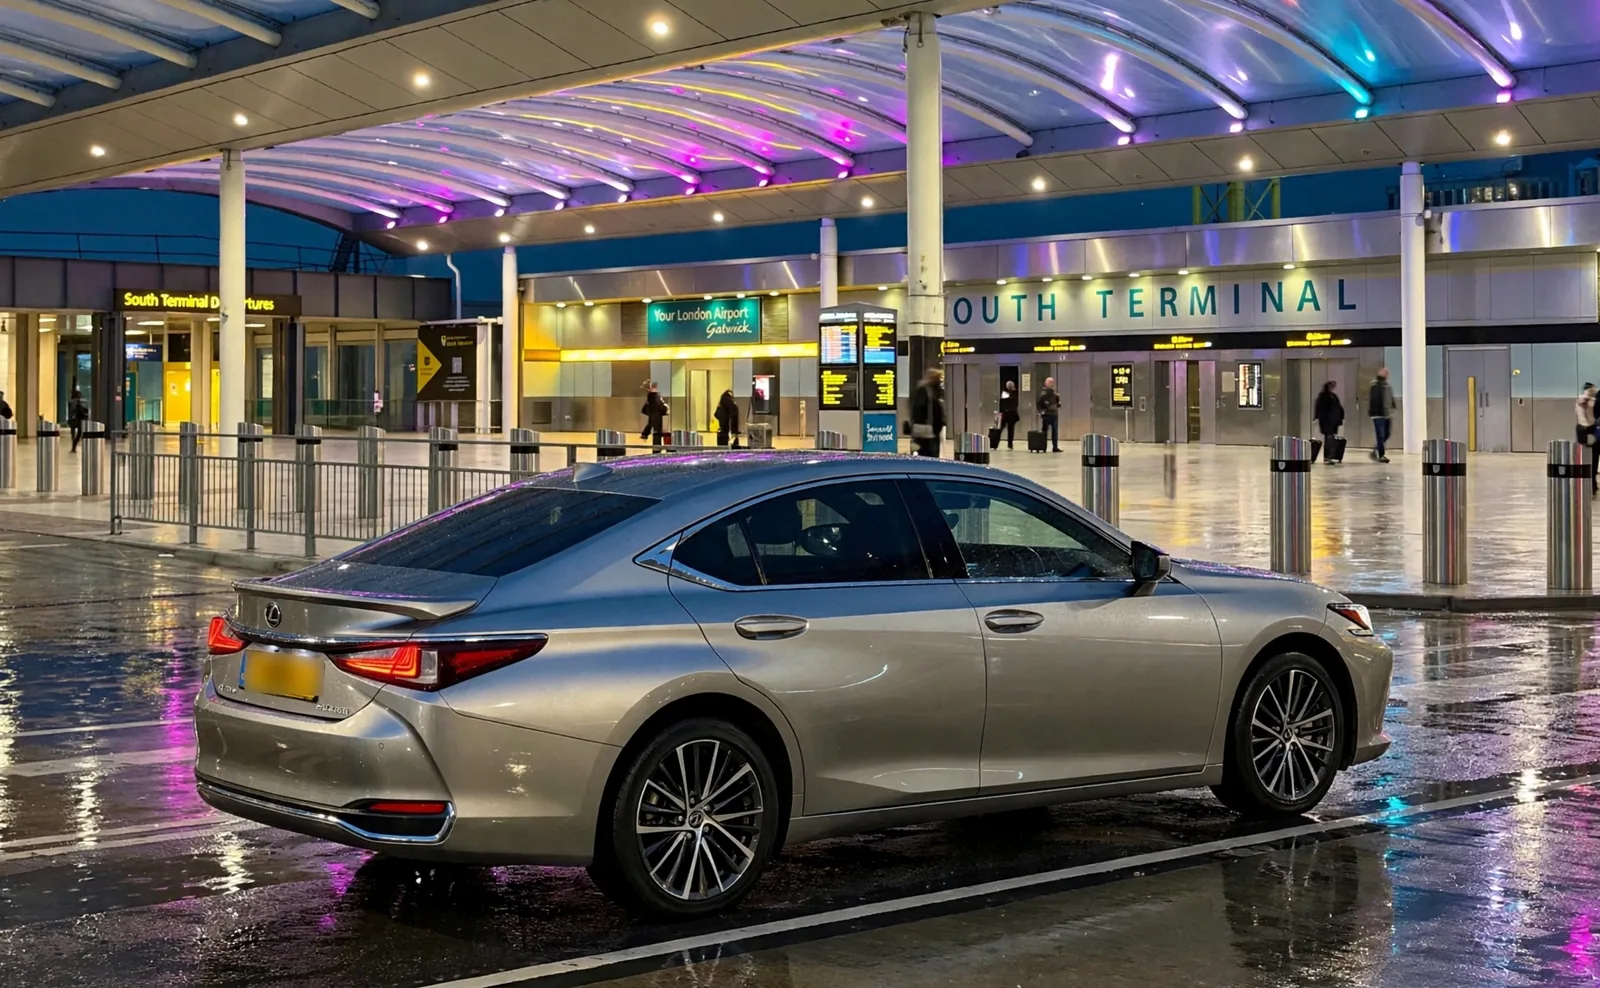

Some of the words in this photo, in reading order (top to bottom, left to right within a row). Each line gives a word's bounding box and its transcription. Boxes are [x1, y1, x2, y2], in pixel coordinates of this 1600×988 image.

[124, 292, 159, 307] South
[160, 294, 209, 309] Terminal
[210, 296, 275, 311] Drtures
[953, 293, 1057, 325] OUTH
[1096, 279, 1357, 318] TERMINAL
[654, 307, 676, 322] Your
[677, 307, 712, 321] London
[713, 306, 749, 322] Airport
